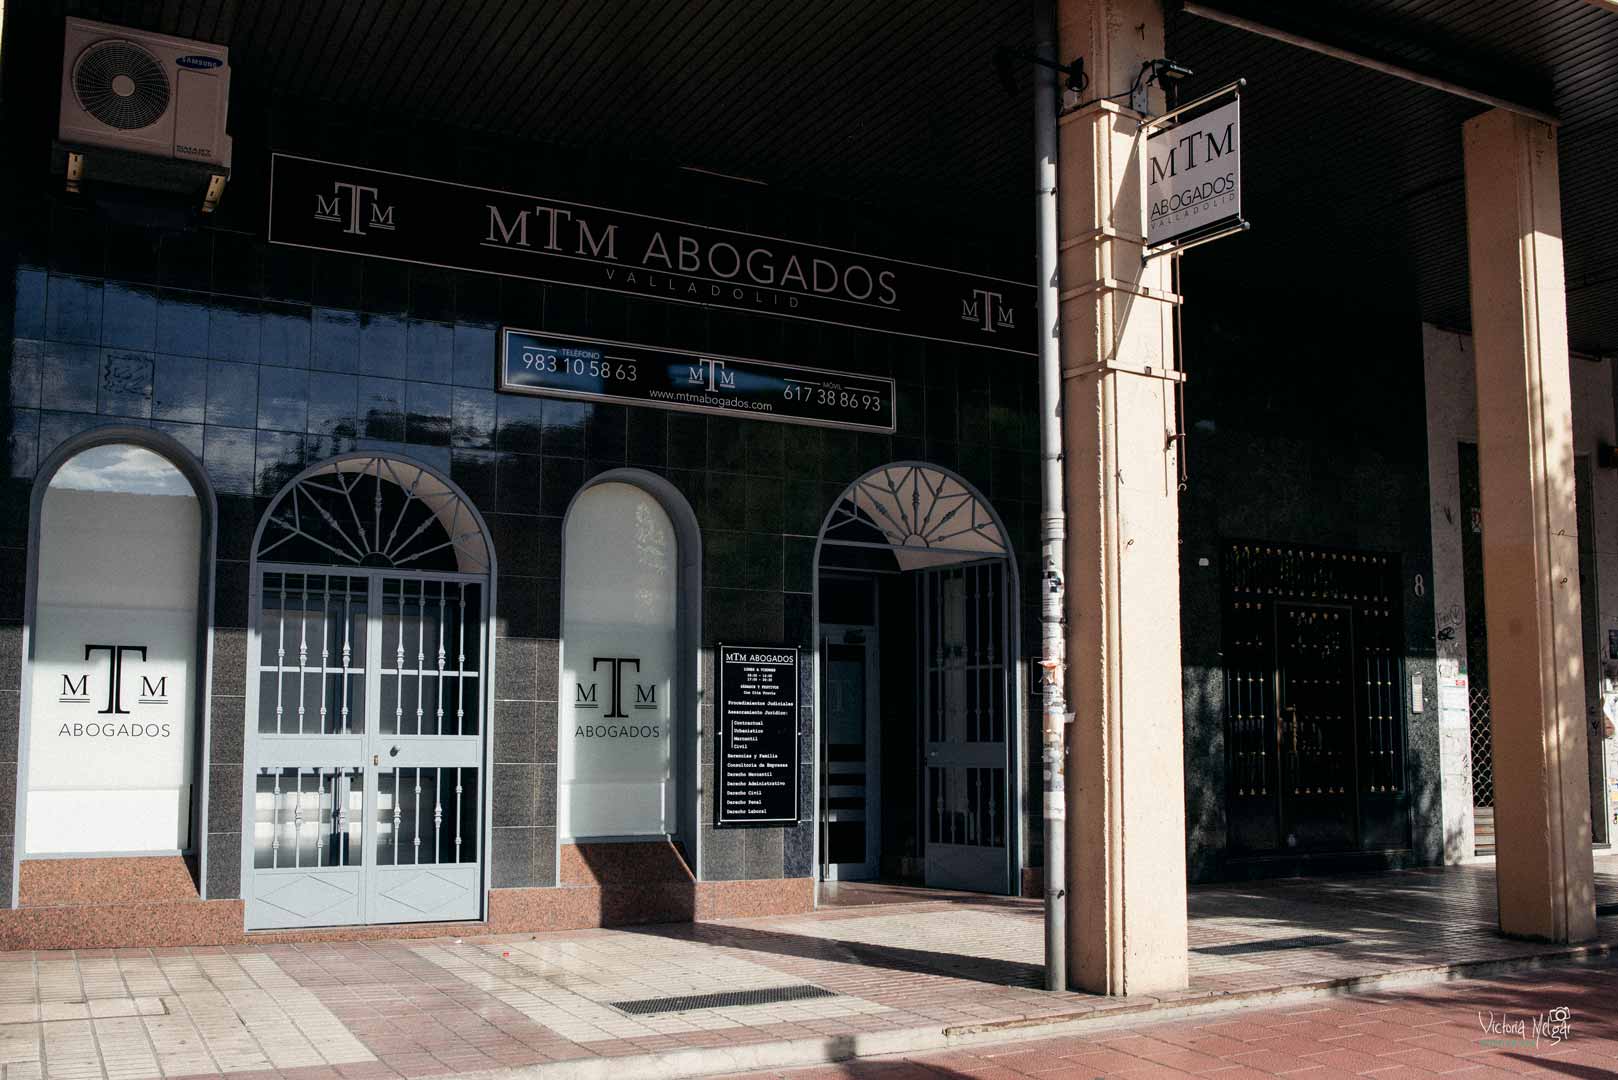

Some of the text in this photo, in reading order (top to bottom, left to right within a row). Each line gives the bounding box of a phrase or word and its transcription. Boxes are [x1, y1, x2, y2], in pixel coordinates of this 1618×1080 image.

[182, 56, 217, 68] SAMSUNG
[1149, 122, 1236, 186] MTM
[314, 181, 396, 236] MTM
[1150, 172, 1234, 219] ABOGADOS
[1150, 193, 1235, 230] VALLADOLID
[485, 204, 897, 305] MTM ABOGADOS
[606, 267, 799, 308] VALLADOLID
[961, 288, 1014, 333] MTM
[522, 352, 637, 382] 983 10 58 63
[688, 358, 735, 393] MTM
[649, 388, 773, 412] www.mtmabogados.com
[783, 384, 881, 412] 617 38 86 93
[1414, 573, 1425, 597] 8
[726, 652, 794, 663] MTM ABOGADOS
[60, 644, 169, 715] MTM
[575, 657, 657, 718] MTM
[58, 722, 171, 738] ABOGADOS
[574, 725, 660, 738] ABOGADOS
